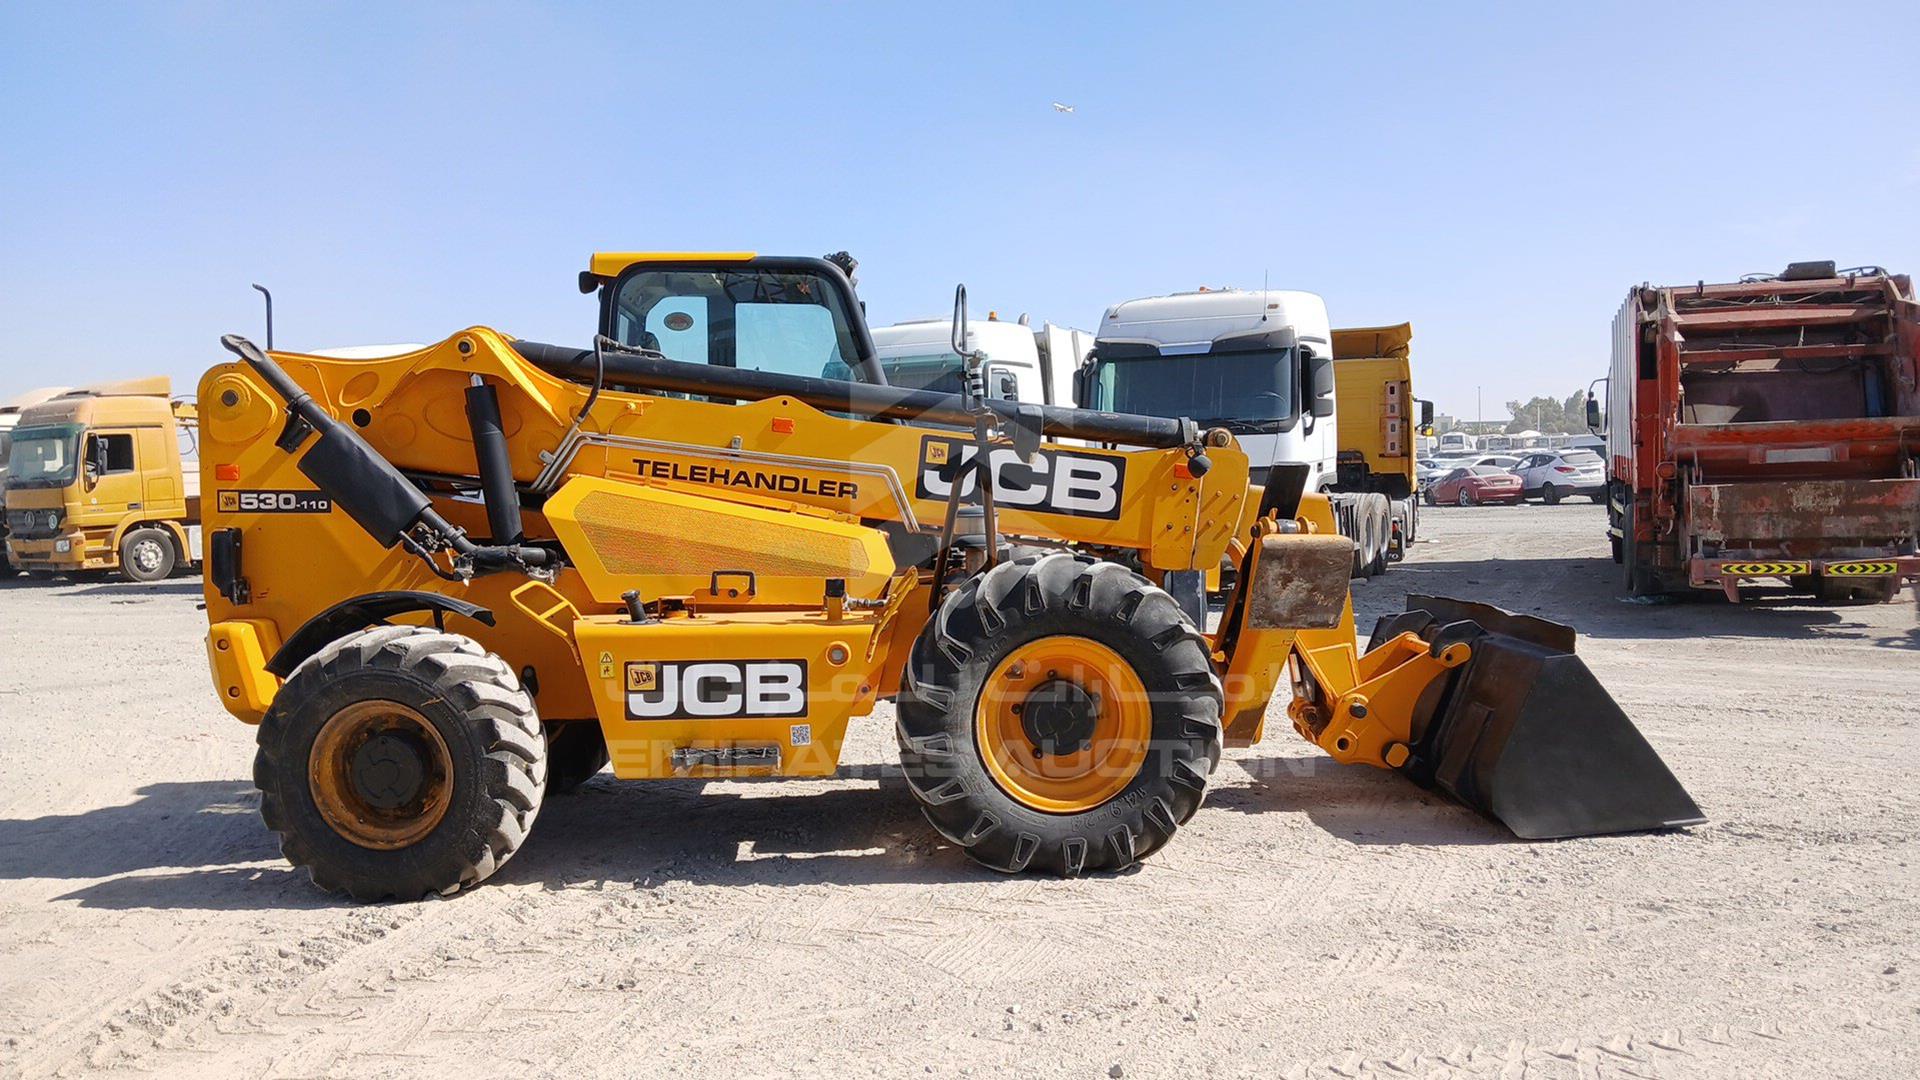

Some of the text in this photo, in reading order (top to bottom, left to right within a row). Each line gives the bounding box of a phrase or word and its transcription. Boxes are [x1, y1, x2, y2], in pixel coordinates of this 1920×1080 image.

[632, 458, 859, 500] TELEHANDLER
[925, 445, 1118, 513] JCB
[628, 663, 805, 717] JCB
[633, 669, 653, 685] JCB
